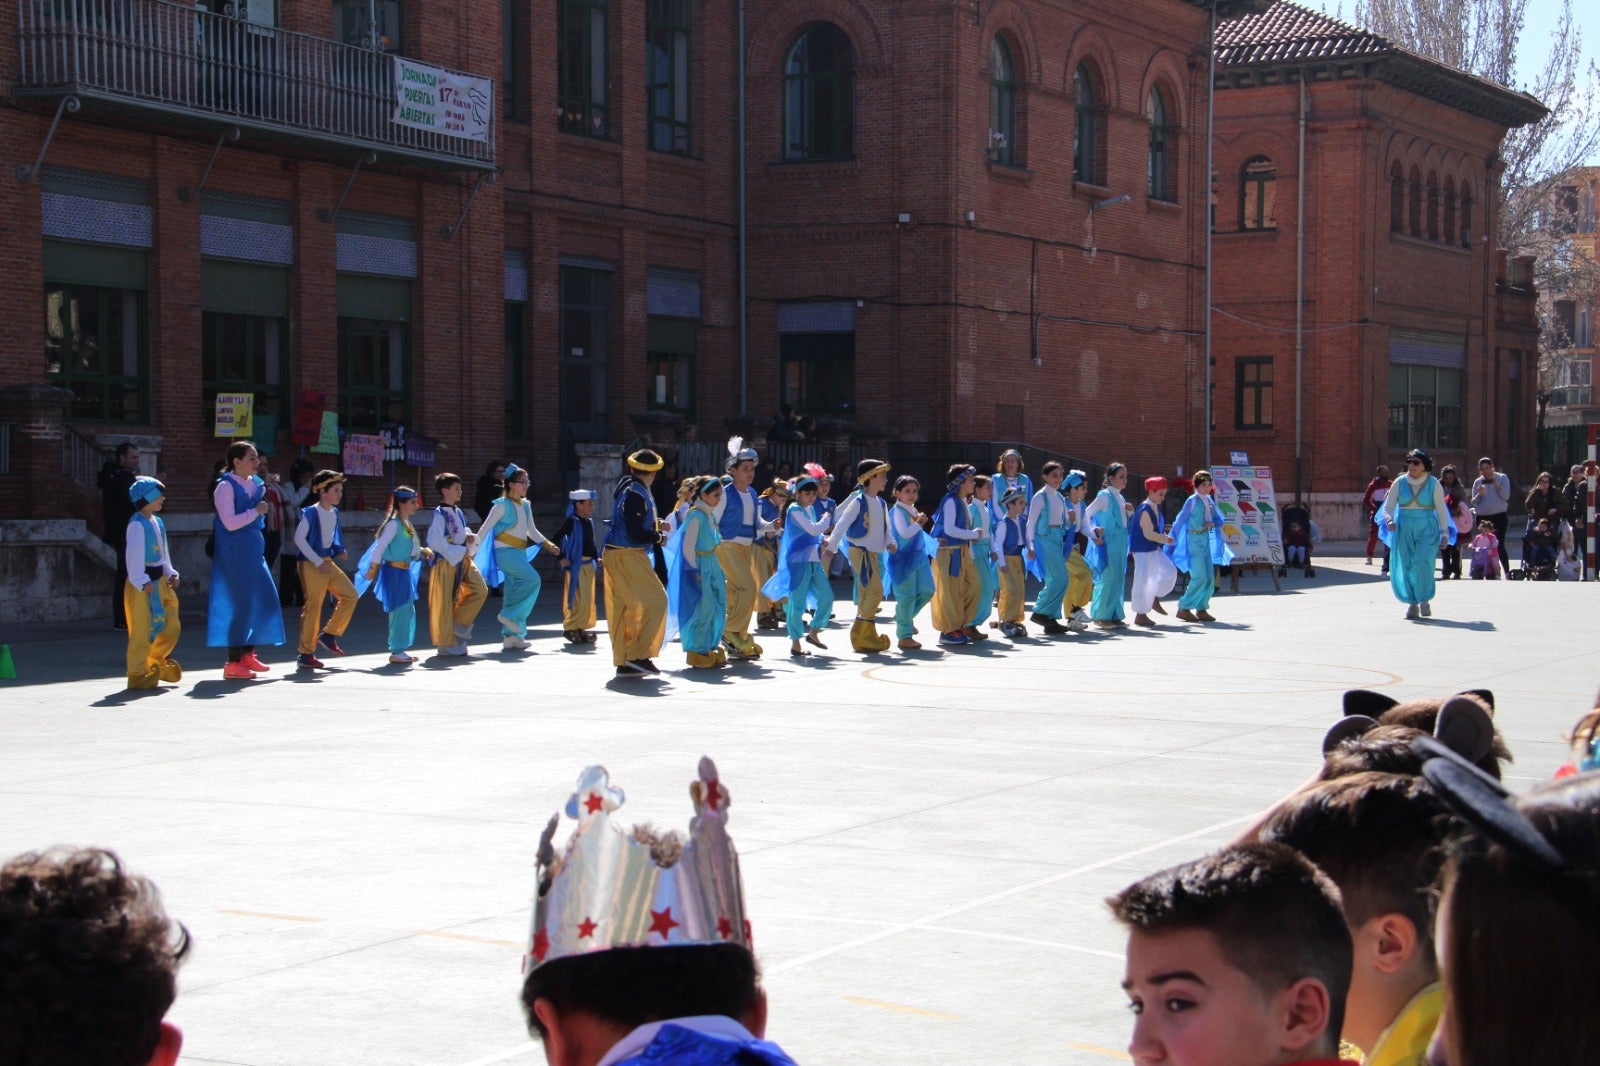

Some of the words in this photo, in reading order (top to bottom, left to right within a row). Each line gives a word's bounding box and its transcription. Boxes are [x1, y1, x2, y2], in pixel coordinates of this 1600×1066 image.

[405, 87, 435, 106] PUERTAS
[439, 87, 453, 103] 17
[400, 106, 435, 126] ABIERTAS
